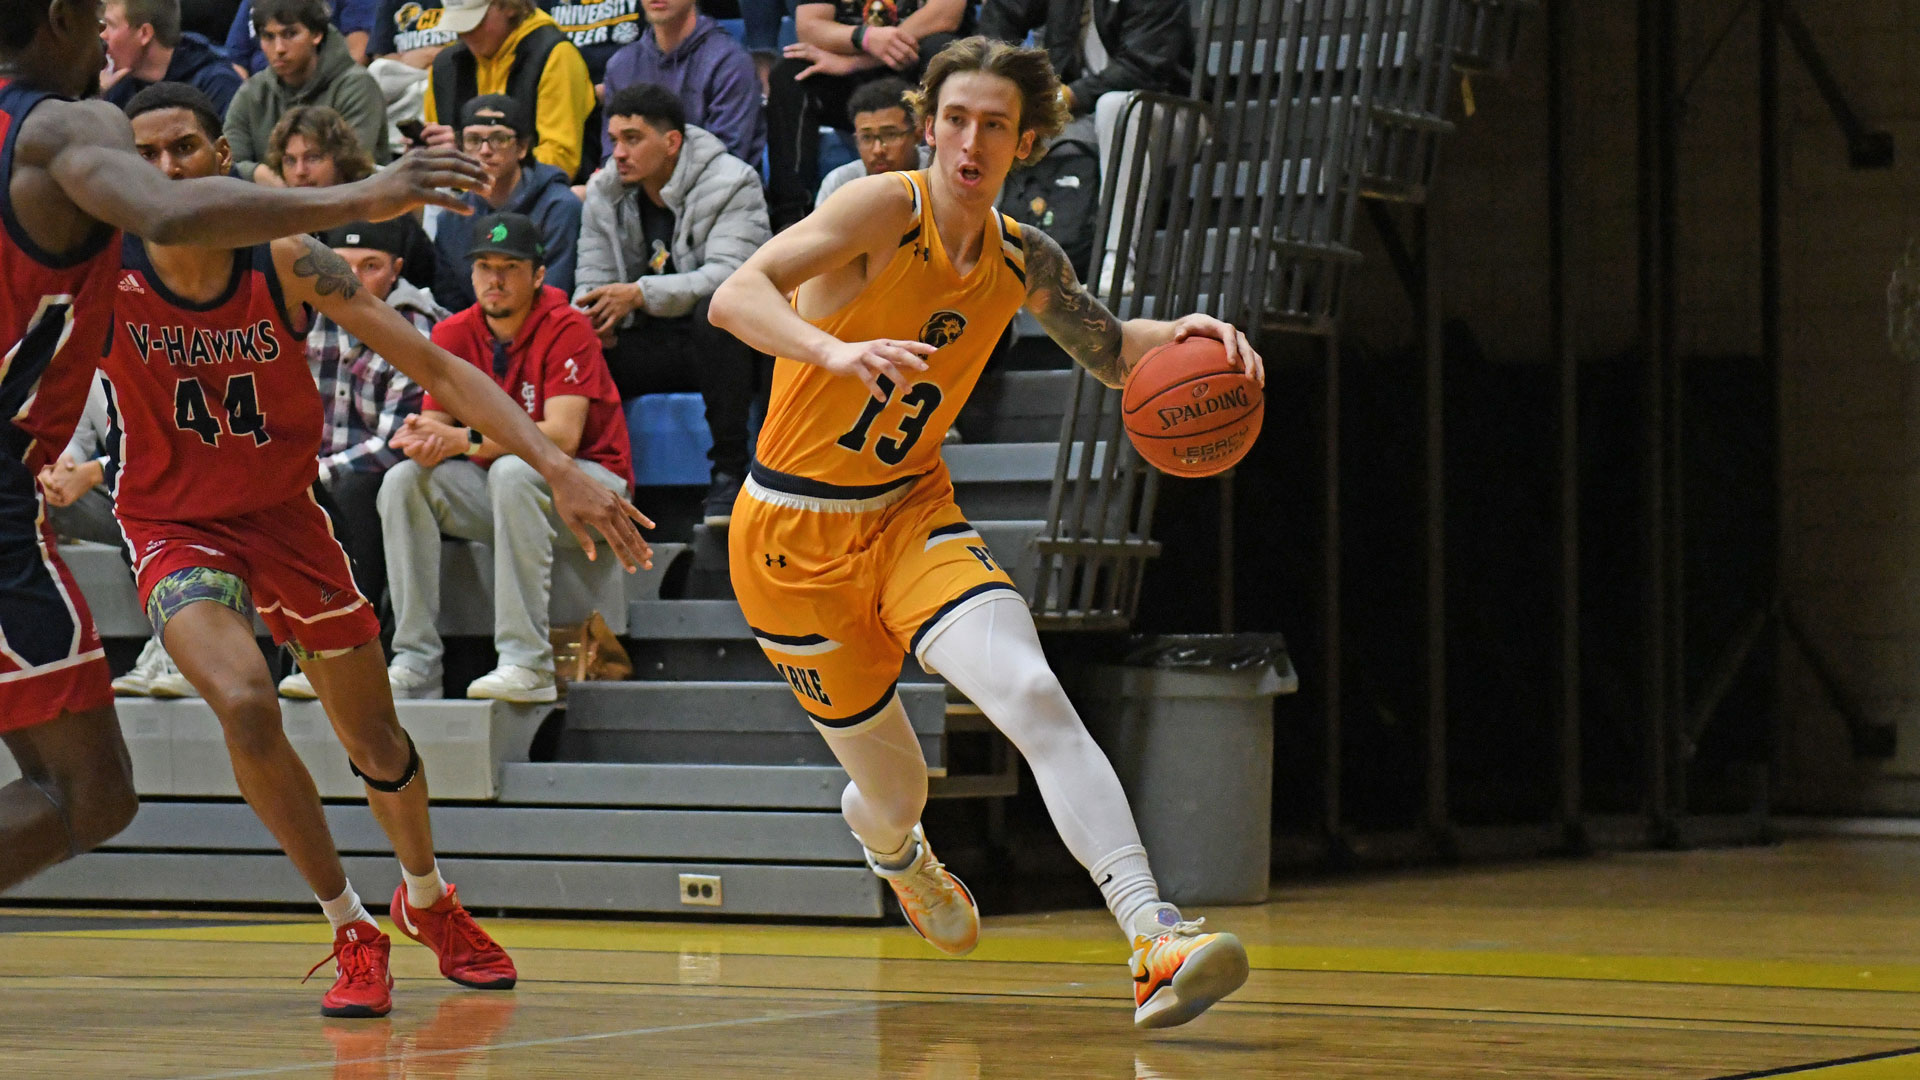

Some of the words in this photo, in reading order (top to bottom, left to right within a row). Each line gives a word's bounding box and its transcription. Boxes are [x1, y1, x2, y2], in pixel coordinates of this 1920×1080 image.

[567, 26, 608, 47] EER
[126, 319, 280, 366] V-HAWKS
[173, 371, 271, 448] 44
[834, 373, 944, 467] 13
[1157, 385, 1249, 431] SPALDING
[1173, 425, 1249, 457] LEGACY
